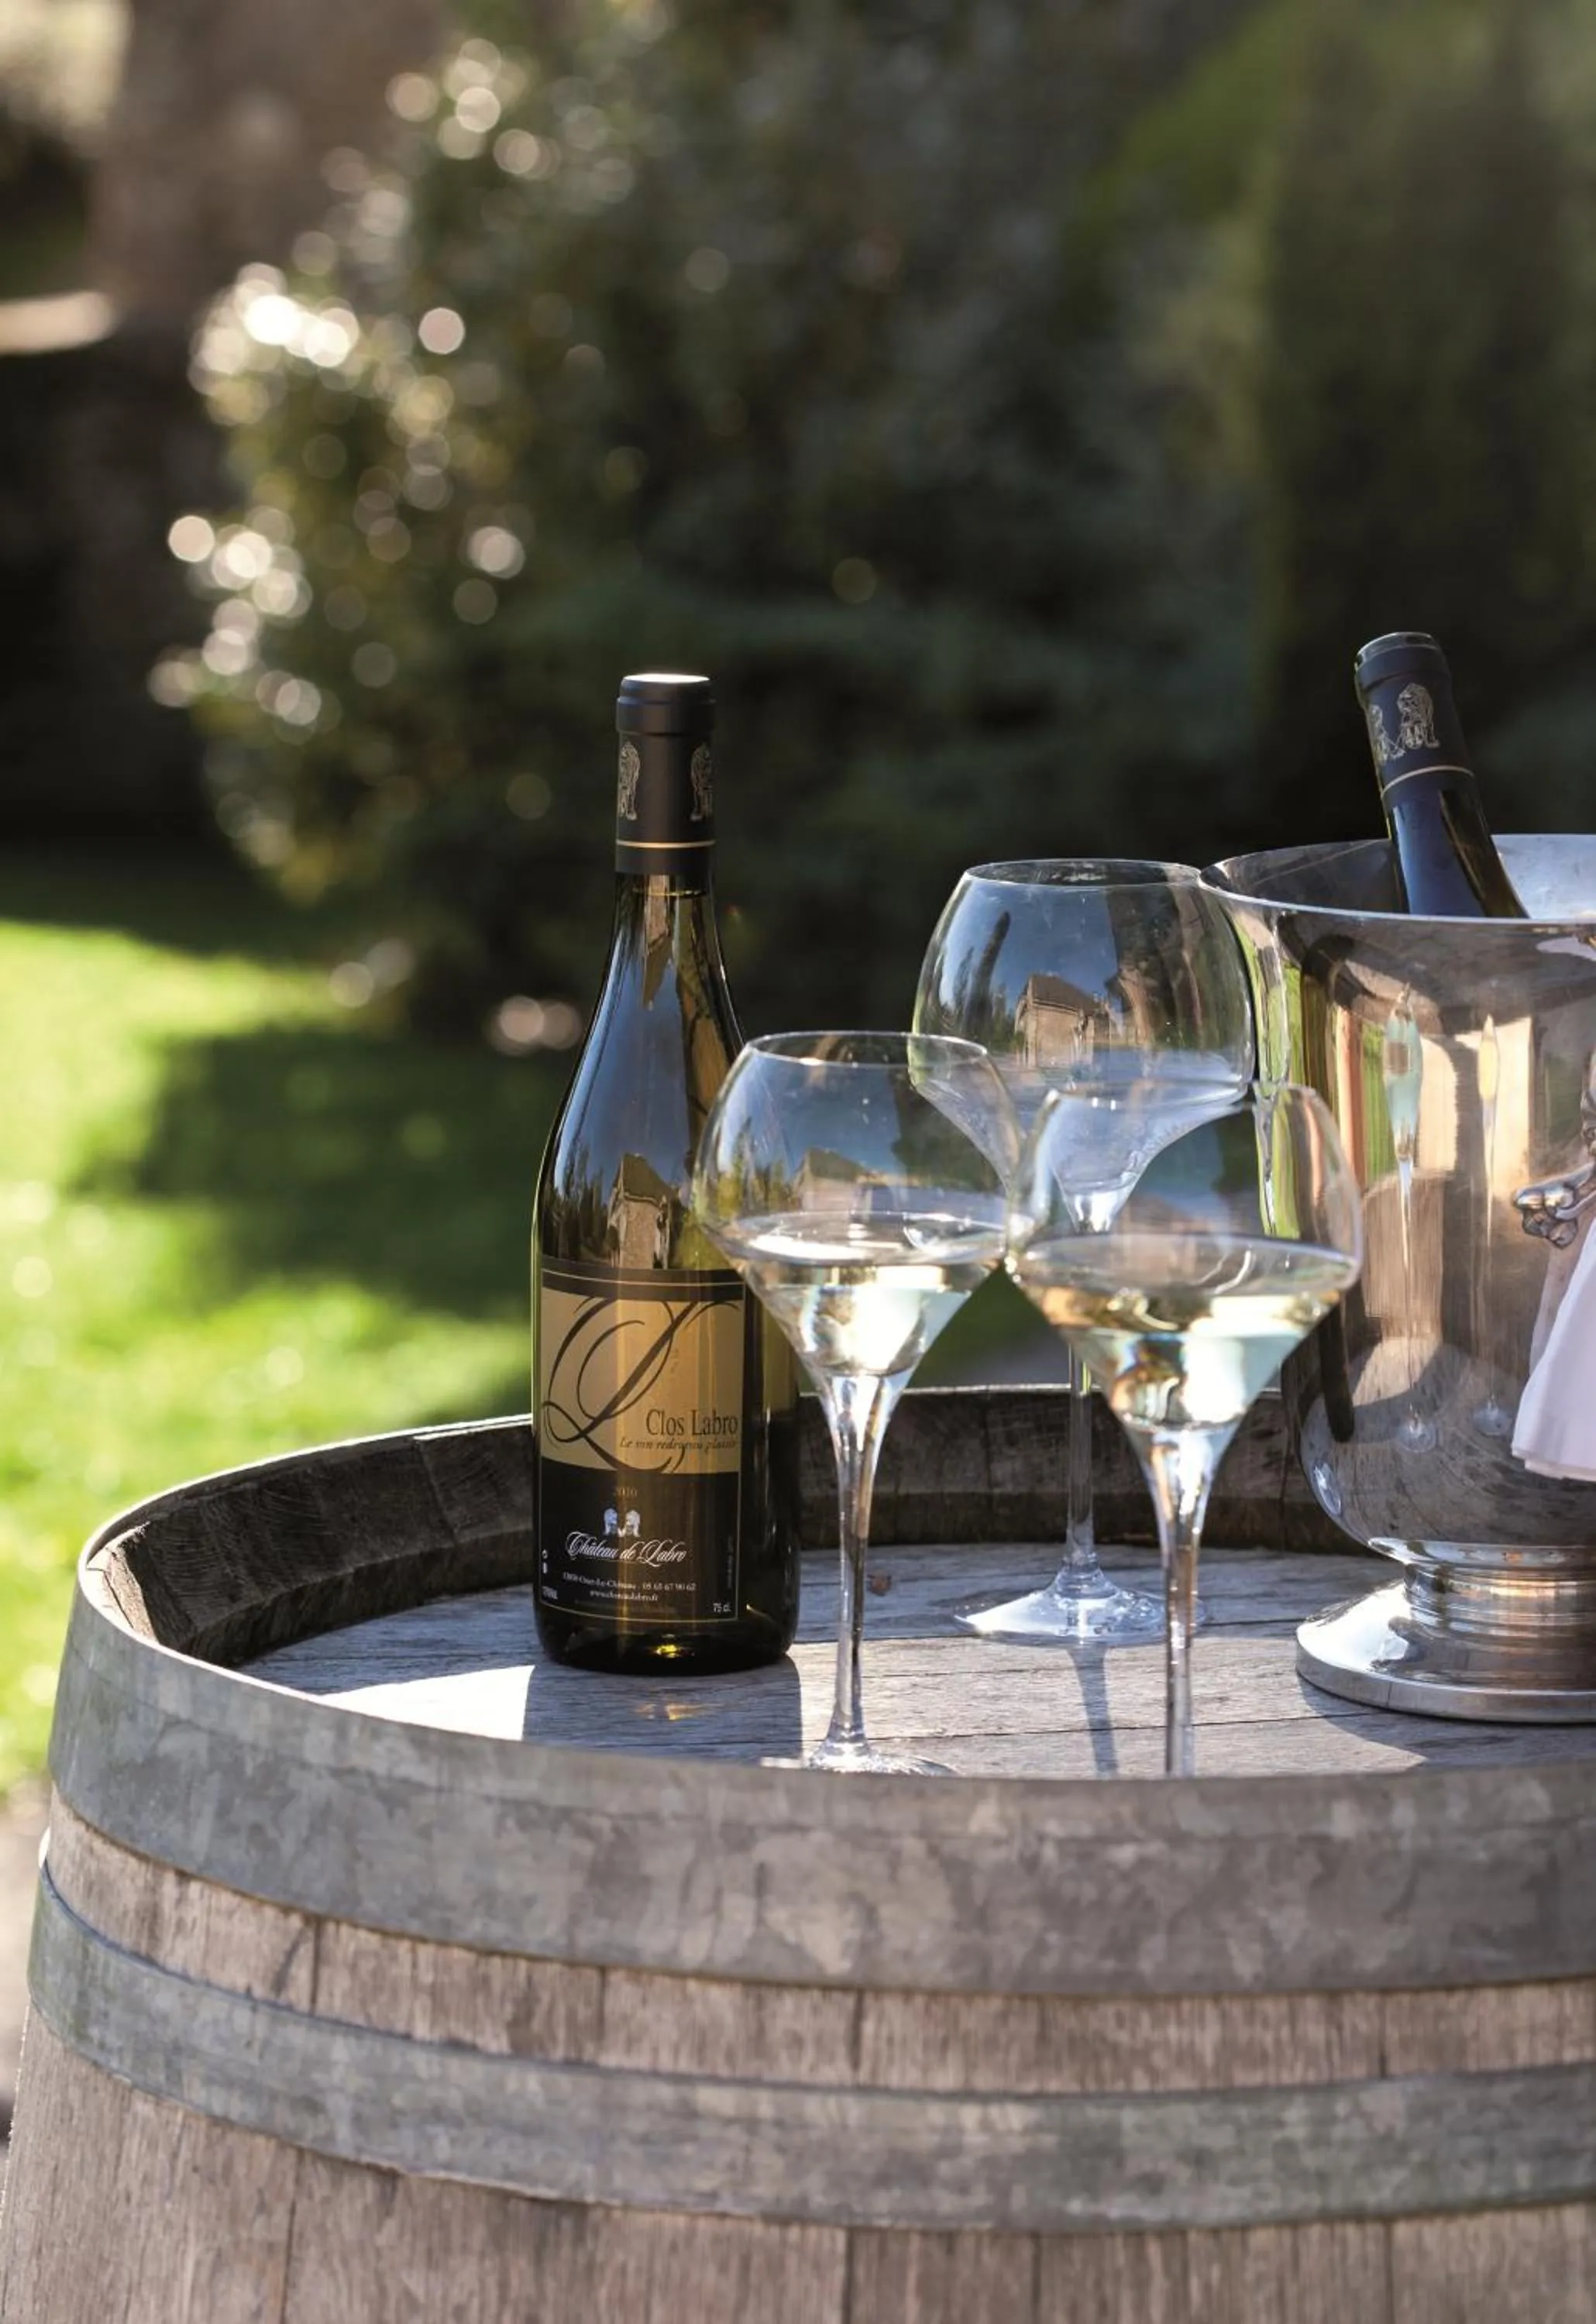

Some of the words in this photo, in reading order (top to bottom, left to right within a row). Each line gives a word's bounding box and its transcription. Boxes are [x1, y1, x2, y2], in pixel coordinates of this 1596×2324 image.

[645, 1408, 686, 1436] Clos
[691, 1408, 739, 1436] Labro
[619, 1435, 633, 1449] Le
[565, 1531, 620, 1561] Château
[619, 1541, 645, 1561] de
[636, 1538, 688, 1568] Labro
[712, 1602, 722, 1613] 75
